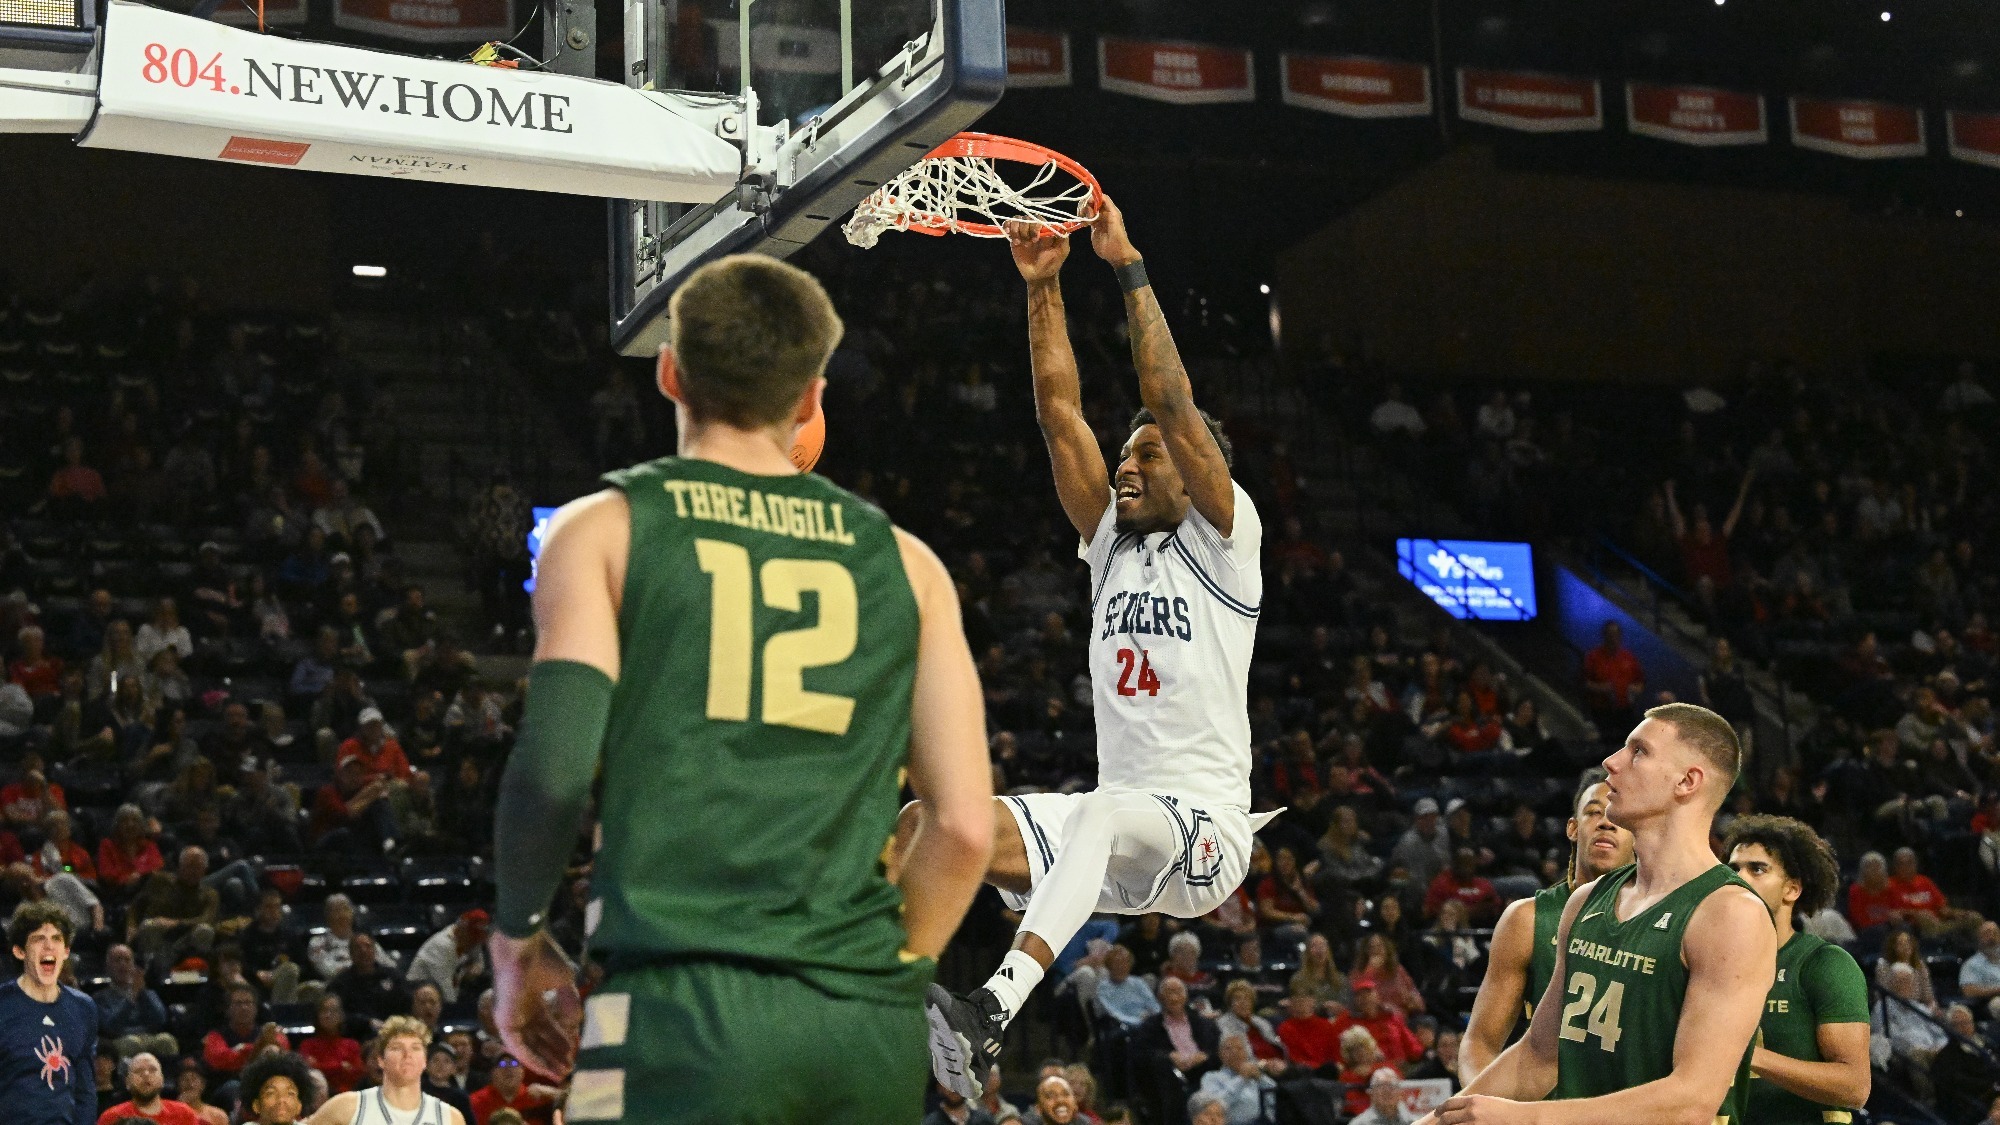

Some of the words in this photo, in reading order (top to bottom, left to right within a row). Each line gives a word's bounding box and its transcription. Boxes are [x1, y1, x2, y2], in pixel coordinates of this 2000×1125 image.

[142, 42, 573, 134] 804.NEW.HOME
[664, 479, 856, 546] THREADGILL
[694, 537, 859, 736] 12
[1117, 648, 1161, 697] 24
[1568, 938, 1656, 975] CHARLOTTE
[1559, 971, 1625, 1052] 24
